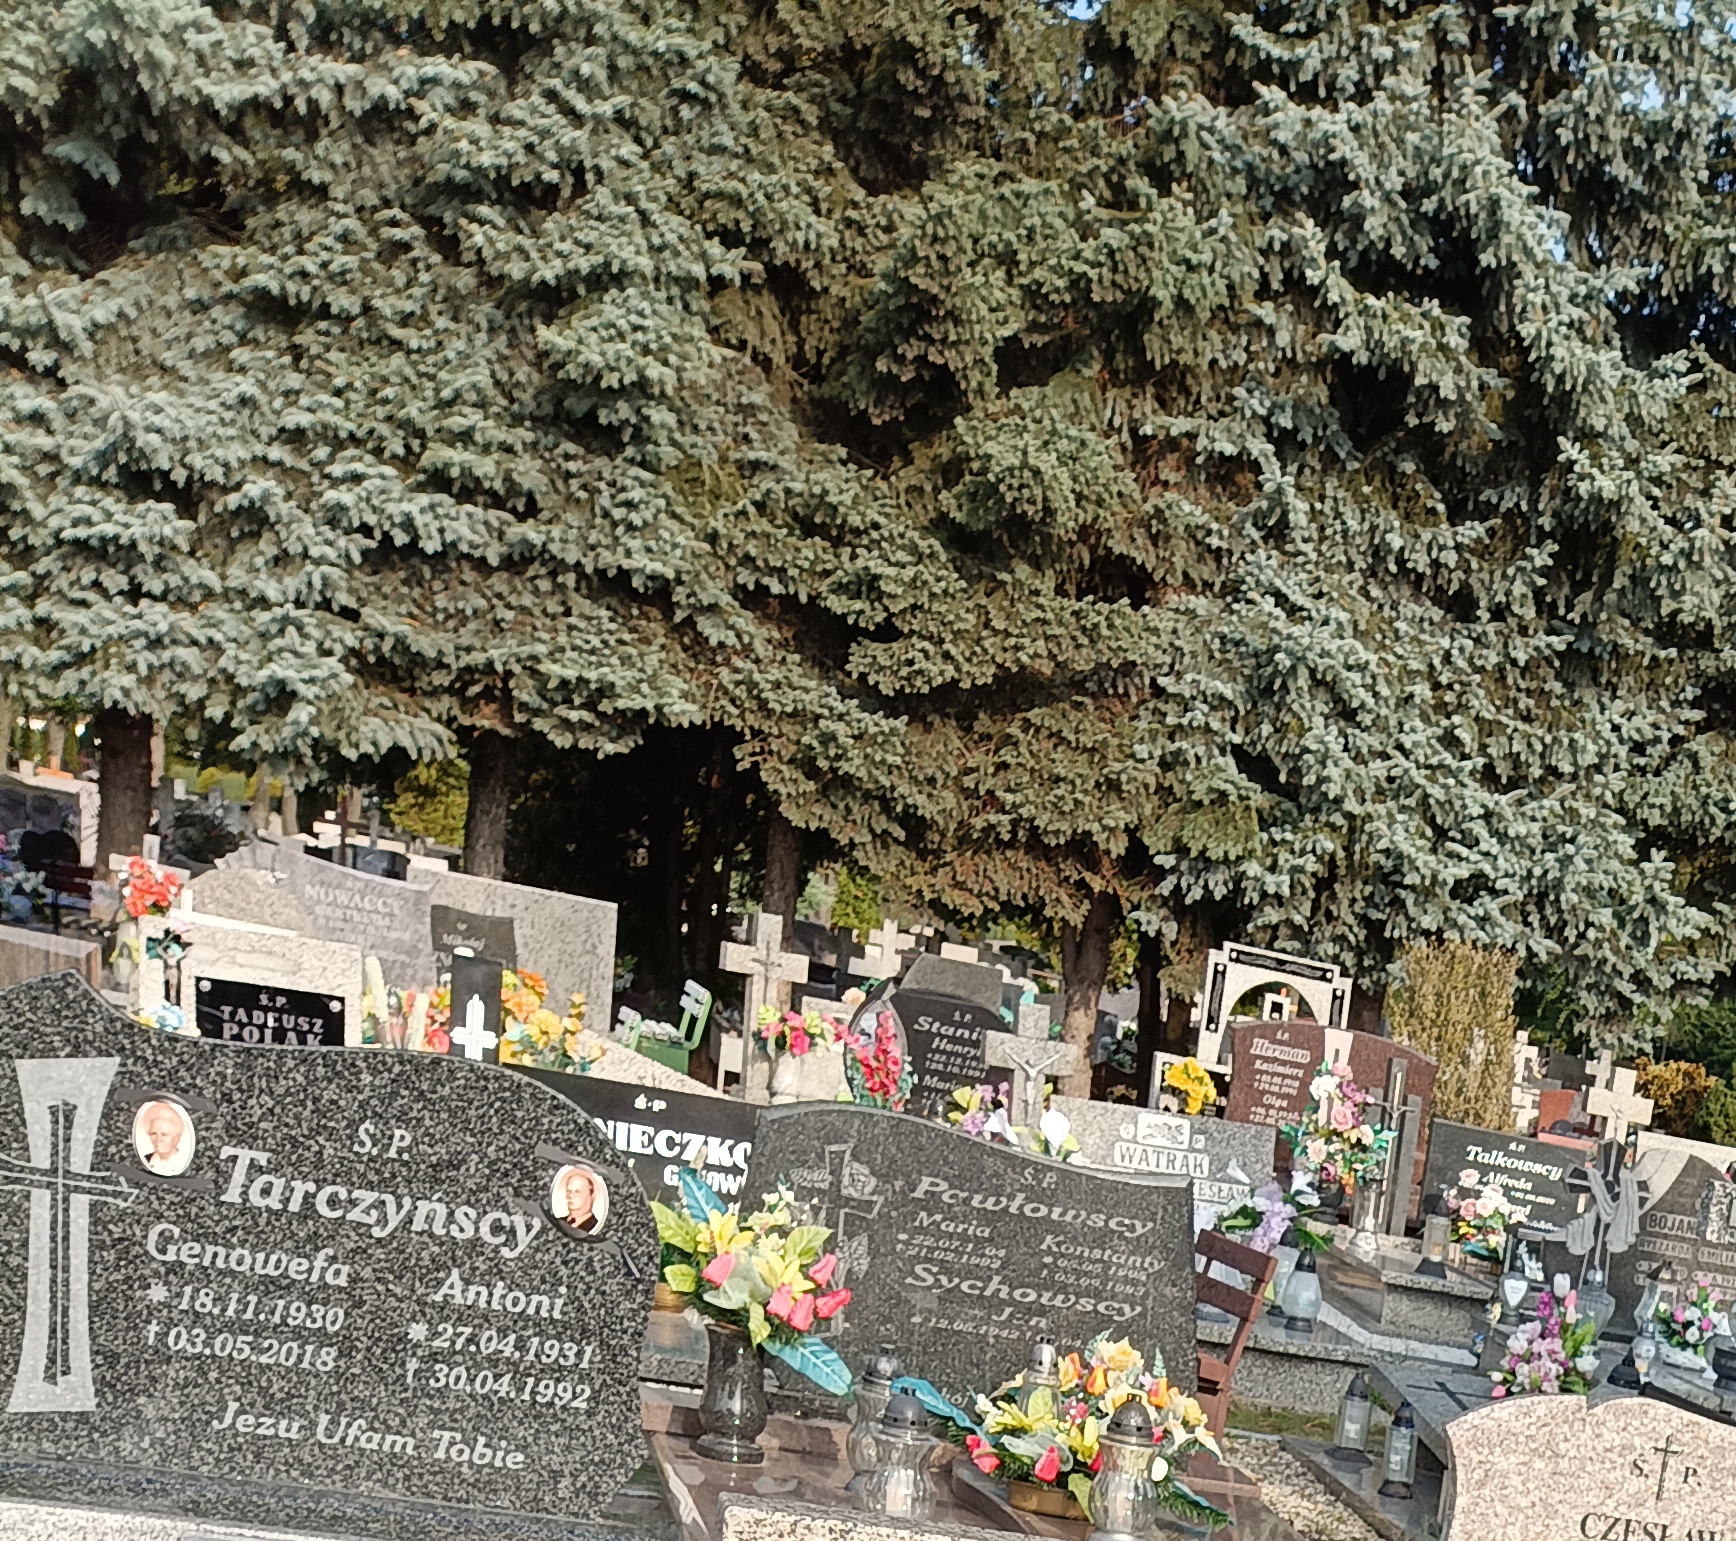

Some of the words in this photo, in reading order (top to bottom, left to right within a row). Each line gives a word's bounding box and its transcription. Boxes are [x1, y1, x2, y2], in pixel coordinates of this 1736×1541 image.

[220, 1005, 324, 1033] TADEUSZ
[222, 1023, 322, 1046] POLAK
[913, 1016, 985, 1041] Stani
[1118, 1144, 1206, 1176] WATRAK
[1466, 1145, 1564, 1181] Talkowscy
[220, 1146, 541, 1258] Tarczyńscy
[913, 1211, 993, 1238] Maria
[147, 1223, 350, 1287] Genowefa
[1039, 1234, 1165, 1273] Konstanty
[433, 1268, 568, 1320] Antoni
[904, 1263, 1143, 1321] Sychowscy
[211, 1401, 300, 1439] Jezu
[315, 1414, 414, 1455] Ufam
[432, 1429, 525, 1469] Tobie
